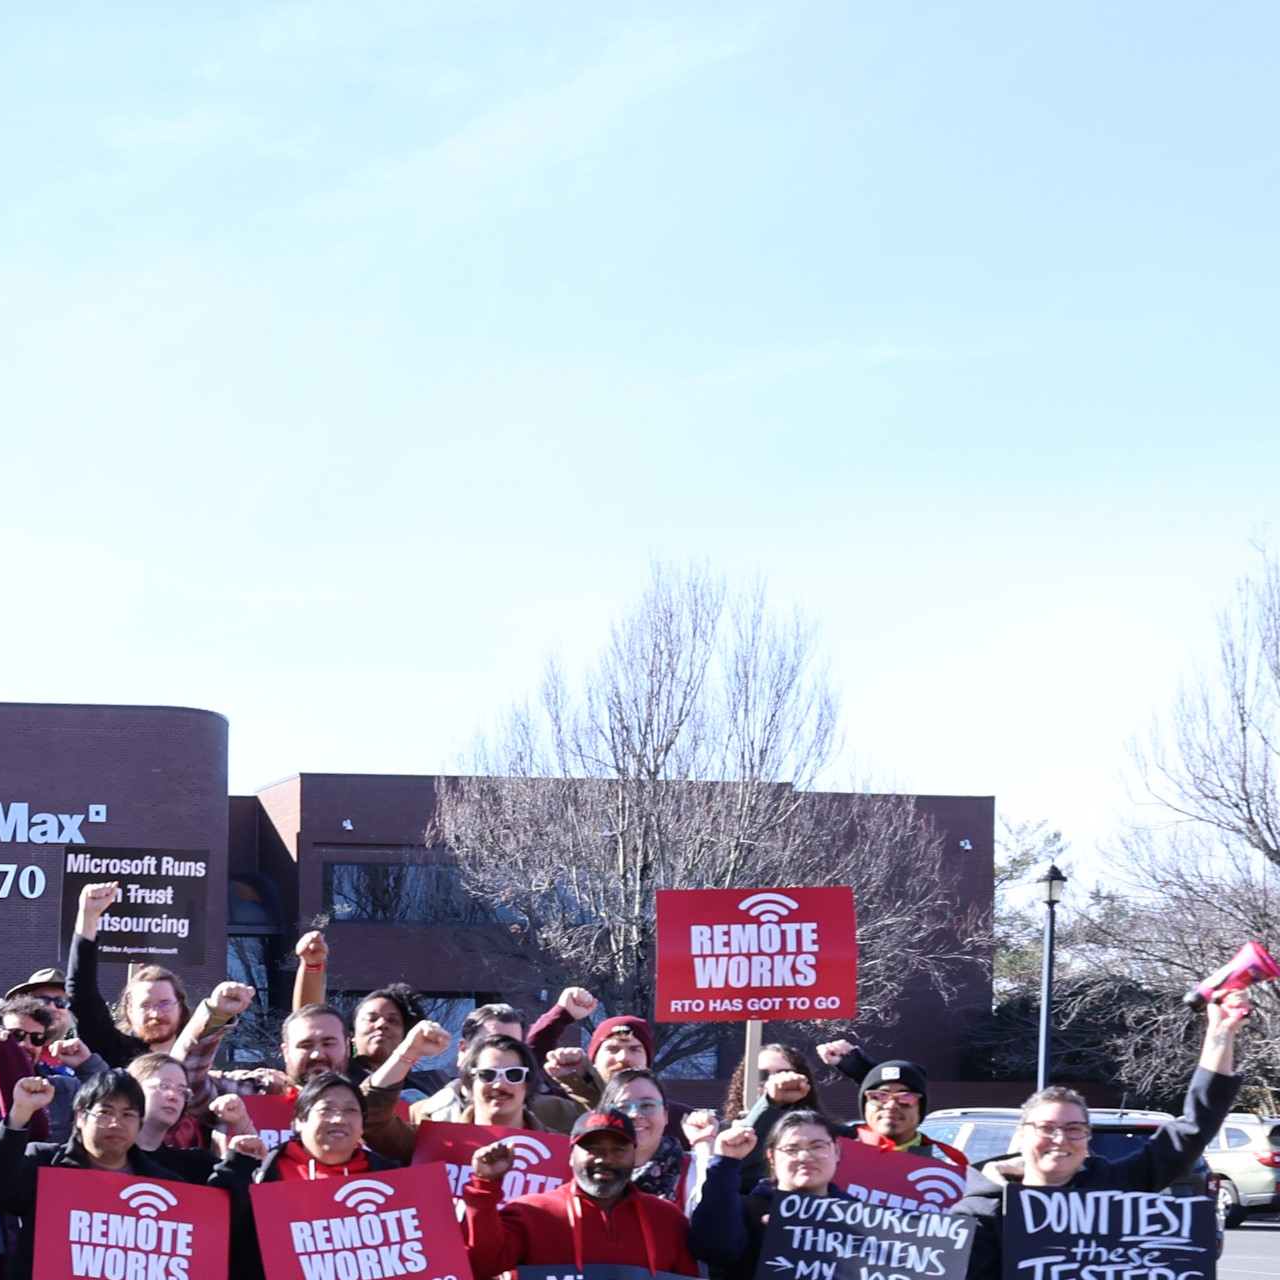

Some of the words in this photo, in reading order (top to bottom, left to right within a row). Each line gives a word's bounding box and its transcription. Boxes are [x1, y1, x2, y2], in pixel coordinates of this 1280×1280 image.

[67, 854, 157, 875] Microsoft
[161, 856, 206, 877] Runs
[127, 884, 174, 904] Trust
[691, 923, 819, 955] REMOTE
[694, 954, 816, 988] WORKS
[671, 999, 705, 1012] RTO
[709, 999, 743, 1011] HAS
[747, 998, 783, 1011] GOT
[786, 997, 810, 1010] TO
[814, 996, 840, 1009] GO
[290, 1206, 424, 1255] REMOTE
[780, 1194, 969, 1252] OUTSOURCING
[1113, 1191, 1213, 1239] TEST
[783, 1224, 946, 1276] THREATENS
[1071, 1238, 1170, 1267] these
